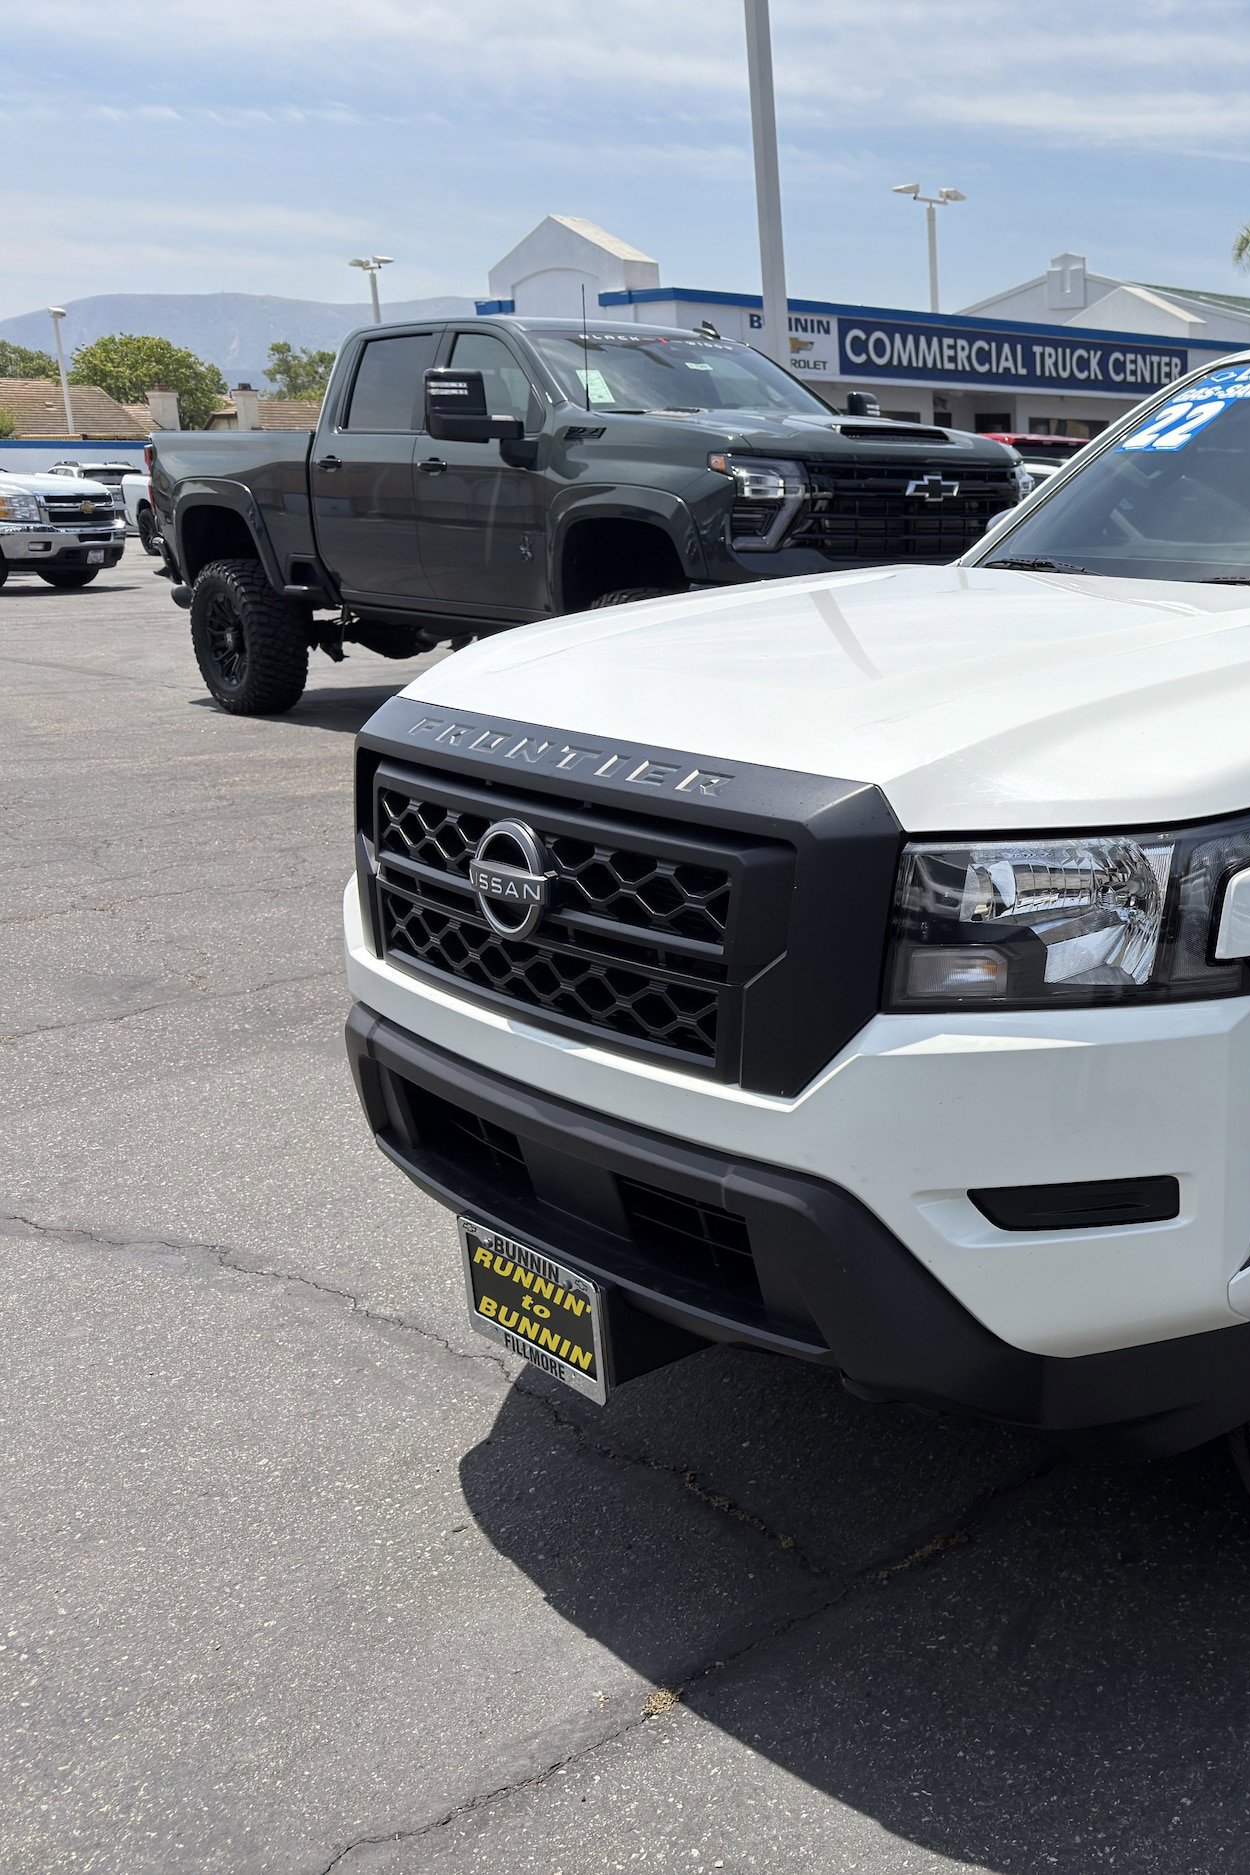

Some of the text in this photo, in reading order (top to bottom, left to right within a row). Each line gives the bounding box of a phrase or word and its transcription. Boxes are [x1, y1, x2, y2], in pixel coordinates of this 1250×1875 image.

[579, 334, 640, 342] BLACK
[749, 313, 831, 335] BNIN
[790, 359, 828, 371] ROLET
[844, 328, 1182, 385] COMMERCIAL TRUCK CENTER
[1121, 400, 1226, 450] 22
[407, 716, 736, 799] FRONTIER
[469, 868, 541, 901] NISSAN
[493, 1235, 559, 1284] BUNNIN
[521, 1294, 551, 1319] to
[478, 1295, 593, 1371] BUNNIN
[505, 1331, 566, 1382] FILLMORE
